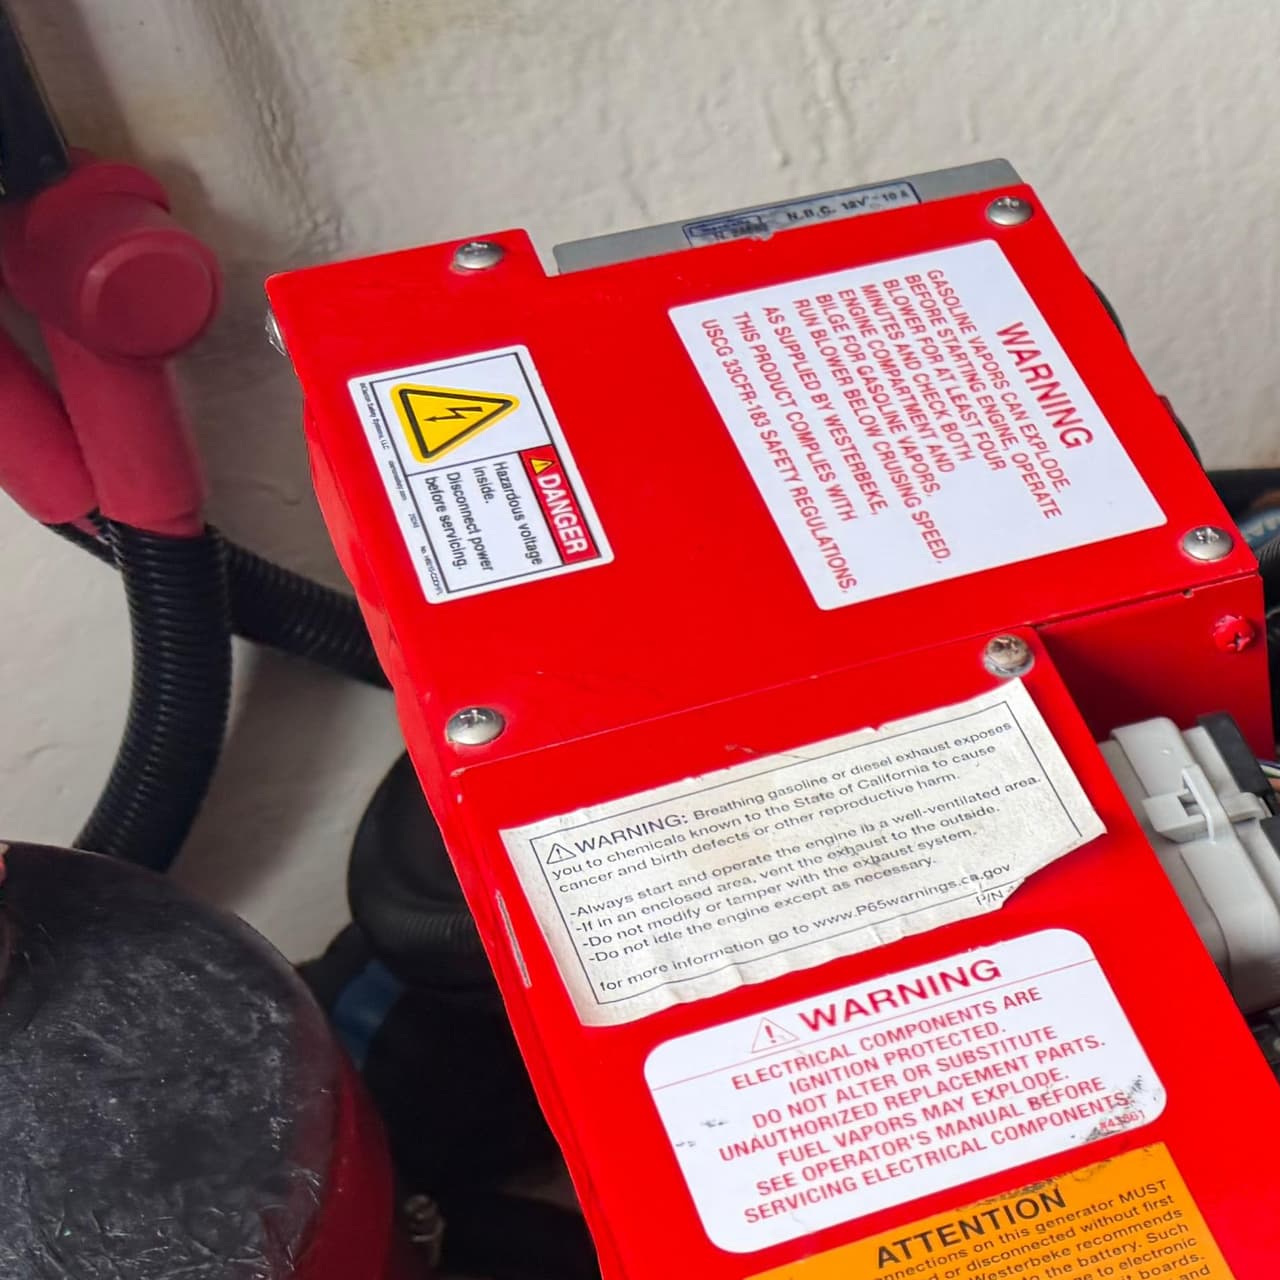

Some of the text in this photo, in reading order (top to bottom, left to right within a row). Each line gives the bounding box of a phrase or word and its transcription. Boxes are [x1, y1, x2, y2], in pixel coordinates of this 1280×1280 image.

[881, 278, 1008, 471] BLOWER FOR AT LEAST FOUR
[903, 273, 1063, 520] BEFORE STARTING ENGINE, OPERATE
[926, 268, 1071, 494] GASOLINE VAPORS CAN EXPLODE.
[995, 321, 1094, 449] WARNING
[700, 318, 858, 593] USCG 33CFR-183 SAFETY REGULATIONS.
[424, 475, 468, 570] before servicing.
[445, 471, 494, 571] Disconnect power
[492, 460, 543, 565] Hazardous voltage
[536, 473, 588, 554] DANGER
[573, 722, 1012, 854] WARNING: Breathing gasoline or diesel exhaust exposes
[730, 986, 1042, 1090] ELECTRICAL COMPONENTS ARE
[798, 958, 1001, 1032] WARNING
[751, 1025, 1058, 1129] DO NOT ALTER OR SUBSTITUTE
[788, 1020, 1006, 1095] IGNITION PROTECTED.
[776, 1067, 1069, 1167] FUEL VAPORS MAY EXPLODE.
[877, 1186, 1066, 1269] ATTENTION
[944, 1267, 960, 1279] or
[965, 1226, 1077, 1272] disconnected
[1079, 1205, 1140, 1233] without
[1141, 1194, 1174, 1212] first
[972, 1239, 995, 1253] on
[997, 1227, 1031, 1244] this
[1034, 1199, 1114, 1235] generator
[1117, 1179, 1166, 1204] MUST
